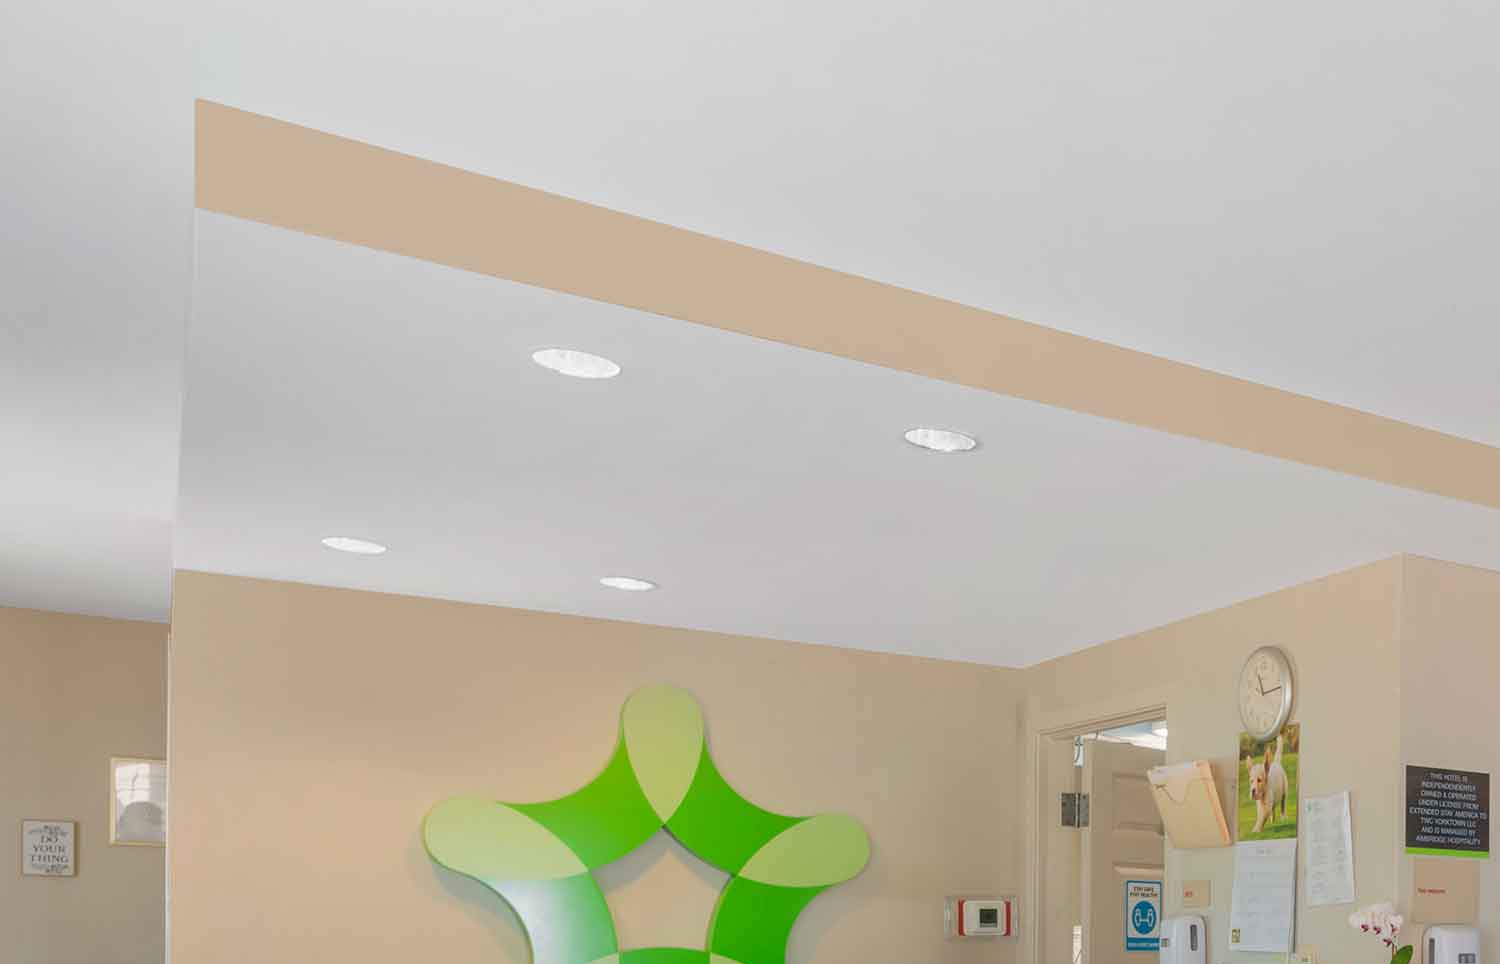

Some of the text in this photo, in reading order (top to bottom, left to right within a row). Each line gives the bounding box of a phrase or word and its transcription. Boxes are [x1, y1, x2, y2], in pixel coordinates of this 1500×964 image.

[1418, 799, 1438, 807] UNDER
[1408, 807, 1439, 815] EXTENDED
[40, 835, 58, 843] DO
[32, 855, 69, 863] THING
